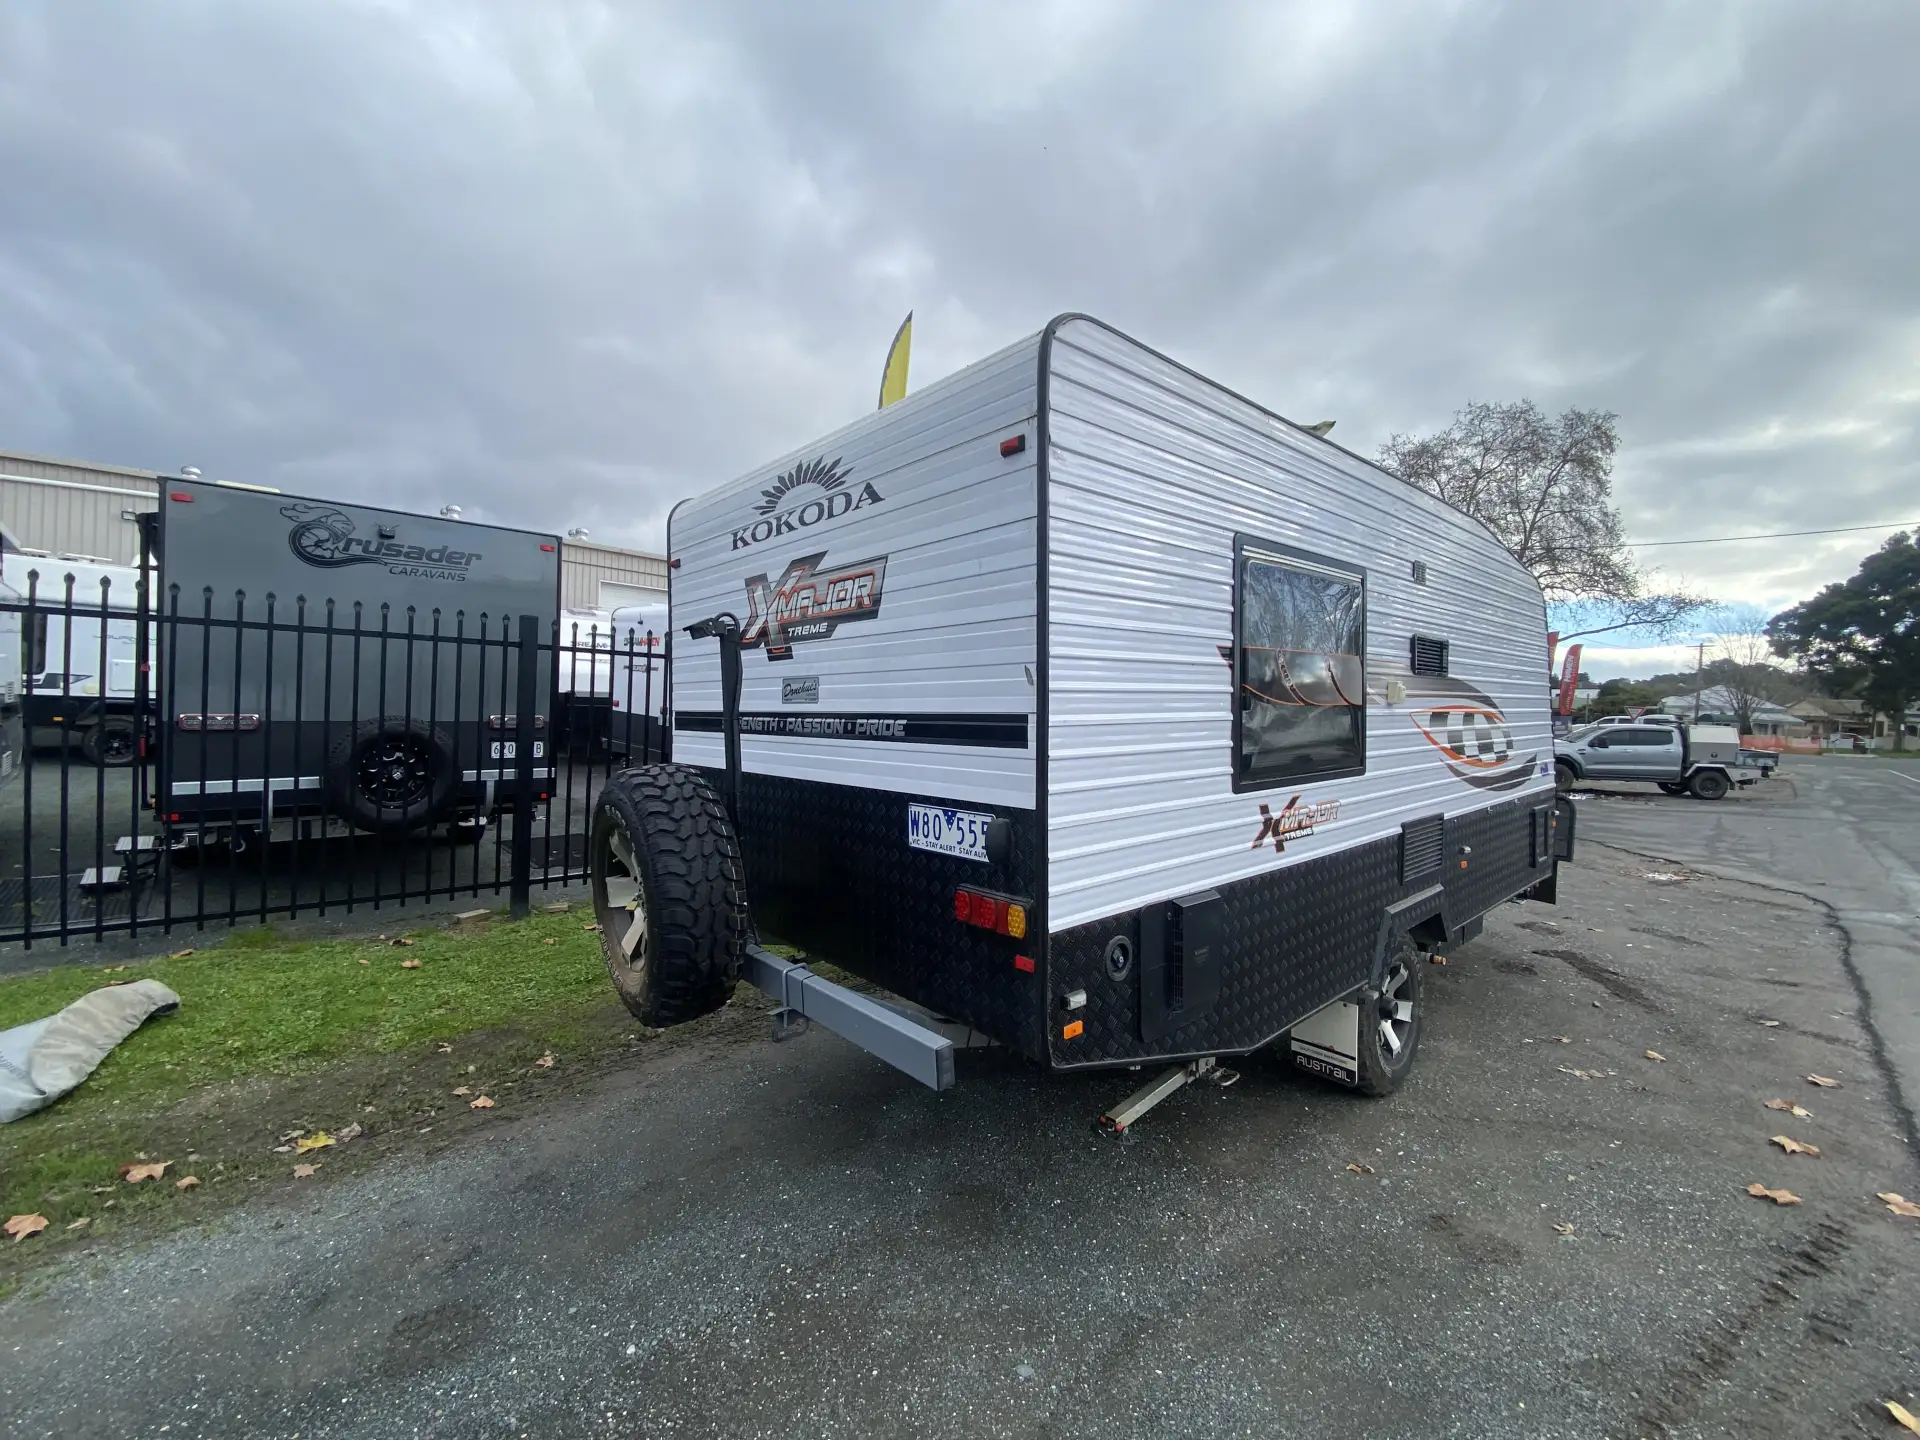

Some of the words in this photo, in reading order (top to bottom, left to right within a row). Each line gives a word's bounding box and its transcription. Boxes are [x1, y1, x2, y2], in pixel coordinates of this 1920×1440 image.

[731, 482, 885, 551] KOKODA
[389, 565, 467, 581] CARAVANS
[786, 718, 845, 734] PASSION
[856, 720, 907, 736] PRIDE
[912, 838, 920, 846] VIC
[926, 841, 938, 849] STAY
[939, 843, 956, 853] ALERT
[958, 847, 974, 856] STAY
